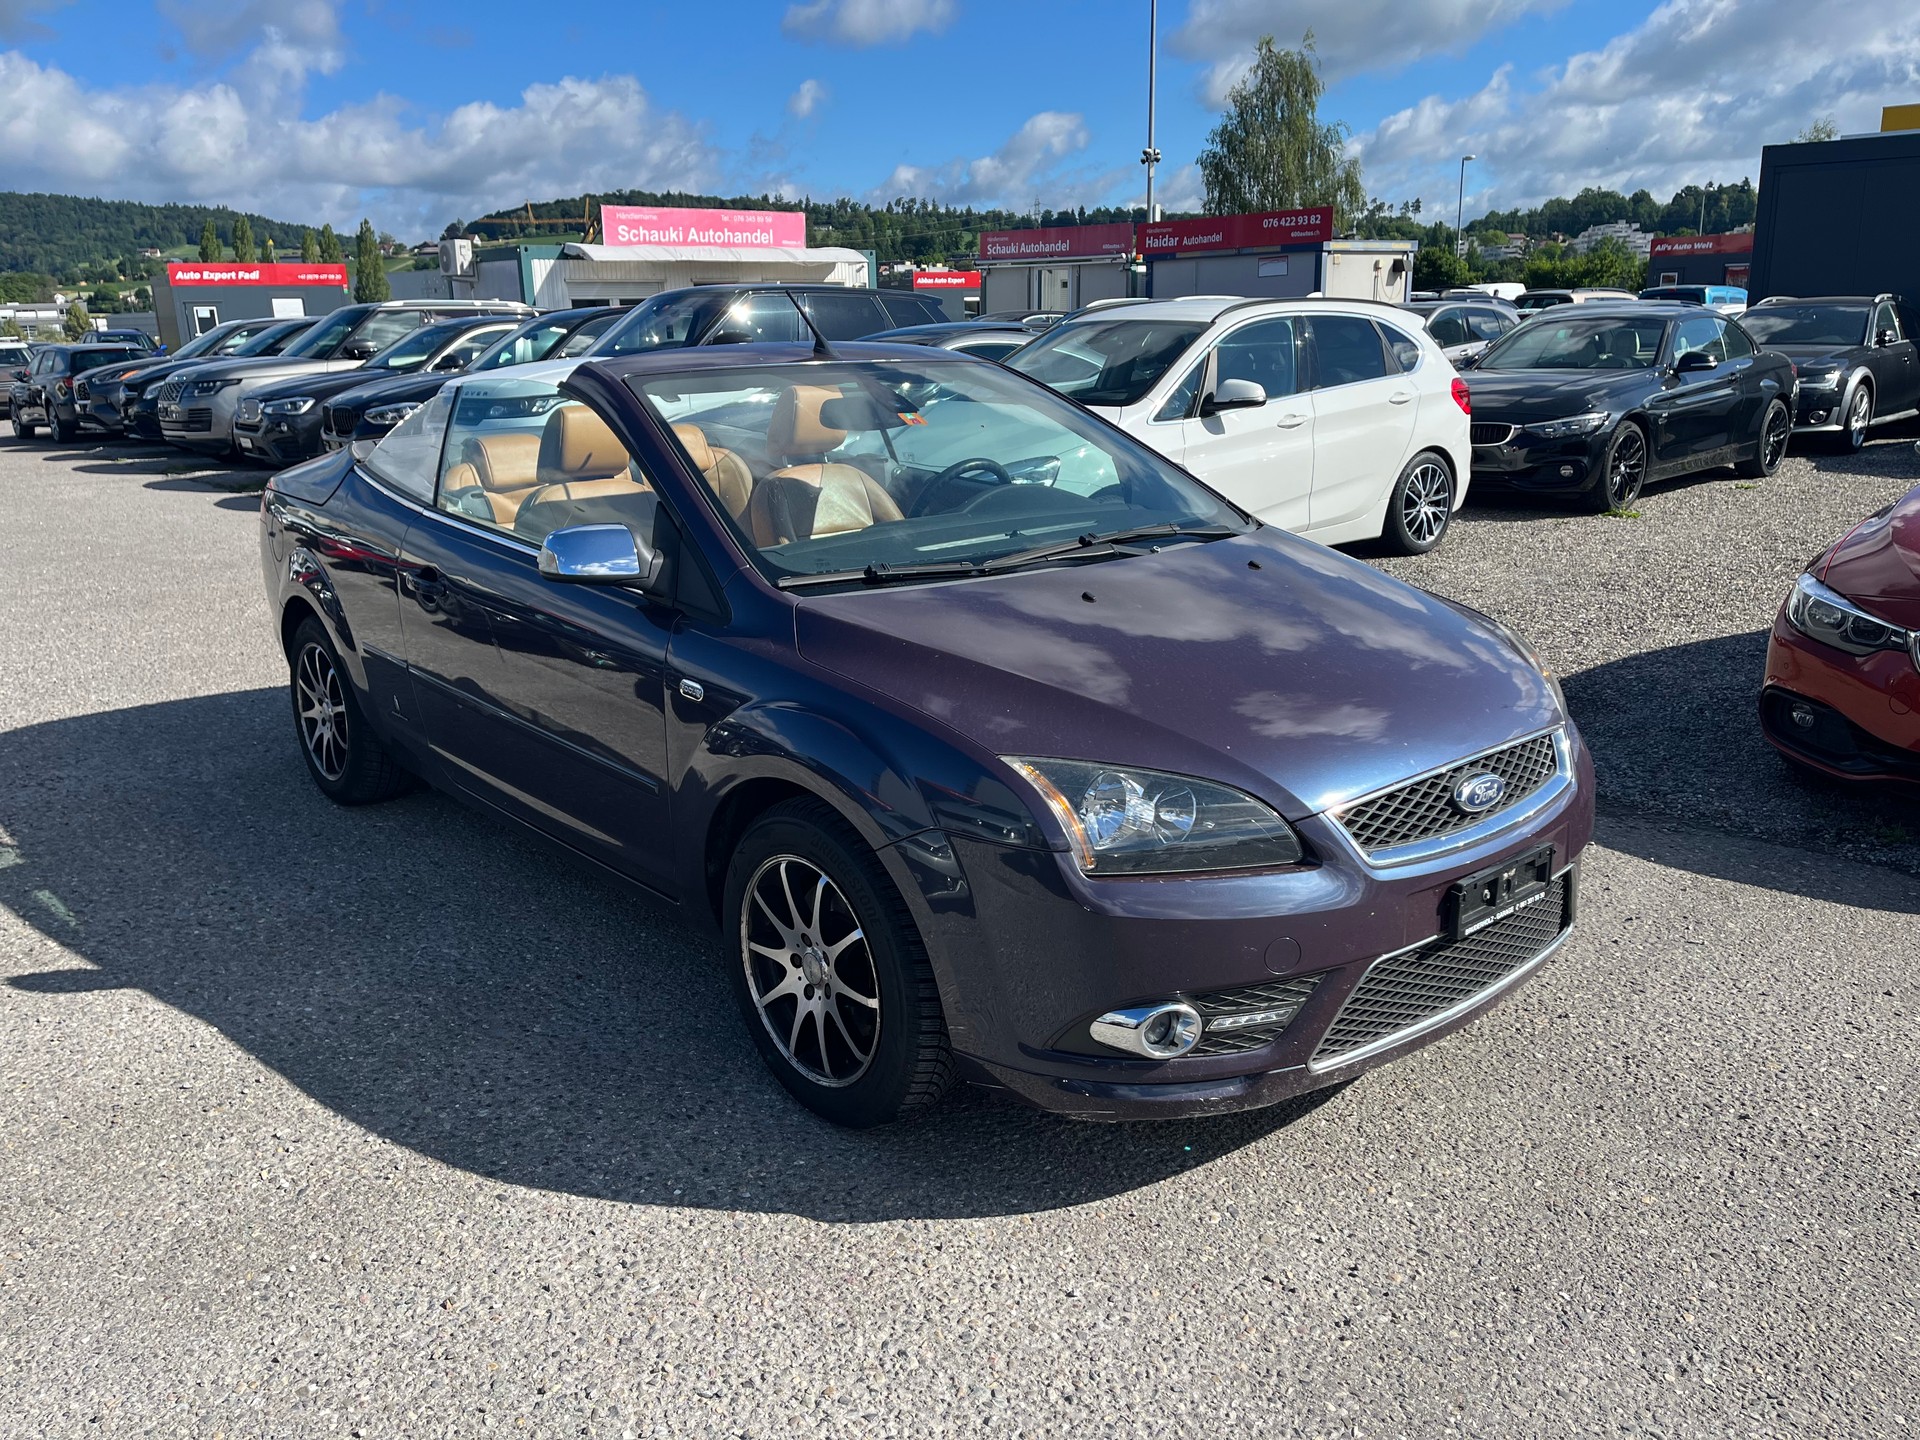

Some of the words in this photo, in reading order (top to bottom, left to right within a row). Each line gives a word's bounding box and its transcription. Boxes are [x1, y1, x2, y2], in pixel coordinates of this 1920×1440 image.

[1263, 218, 1279, 228] 076
[1280, 216, 1296, 227] 422
[1297, 215, 1308, 225] 93
[1310, 214, 1321, 224] 82
[617, 225, 683, 242] Schauki
[687, 227, 773, 244] Autohandel
[1145, 234, 1179, 248] Haidar
[1182, 232, 1223, 246] Autohandel
[987, 242, 1019, 255] Schauki
[1019, 239, 1070, 253] Autohandel
[1655, 243, 1672, 252] Ali's
[1672, 243, 1692, 251] Auto
[1693, 241, 1713, 249] Welt
[175, 270, 201, 280] Auto
[202, 270, 236, 282] Export
[238, 270, 260, 280] Fadi
[947, 277, 966, 285] Export
[1474, 781, 1498, 804] Ford
